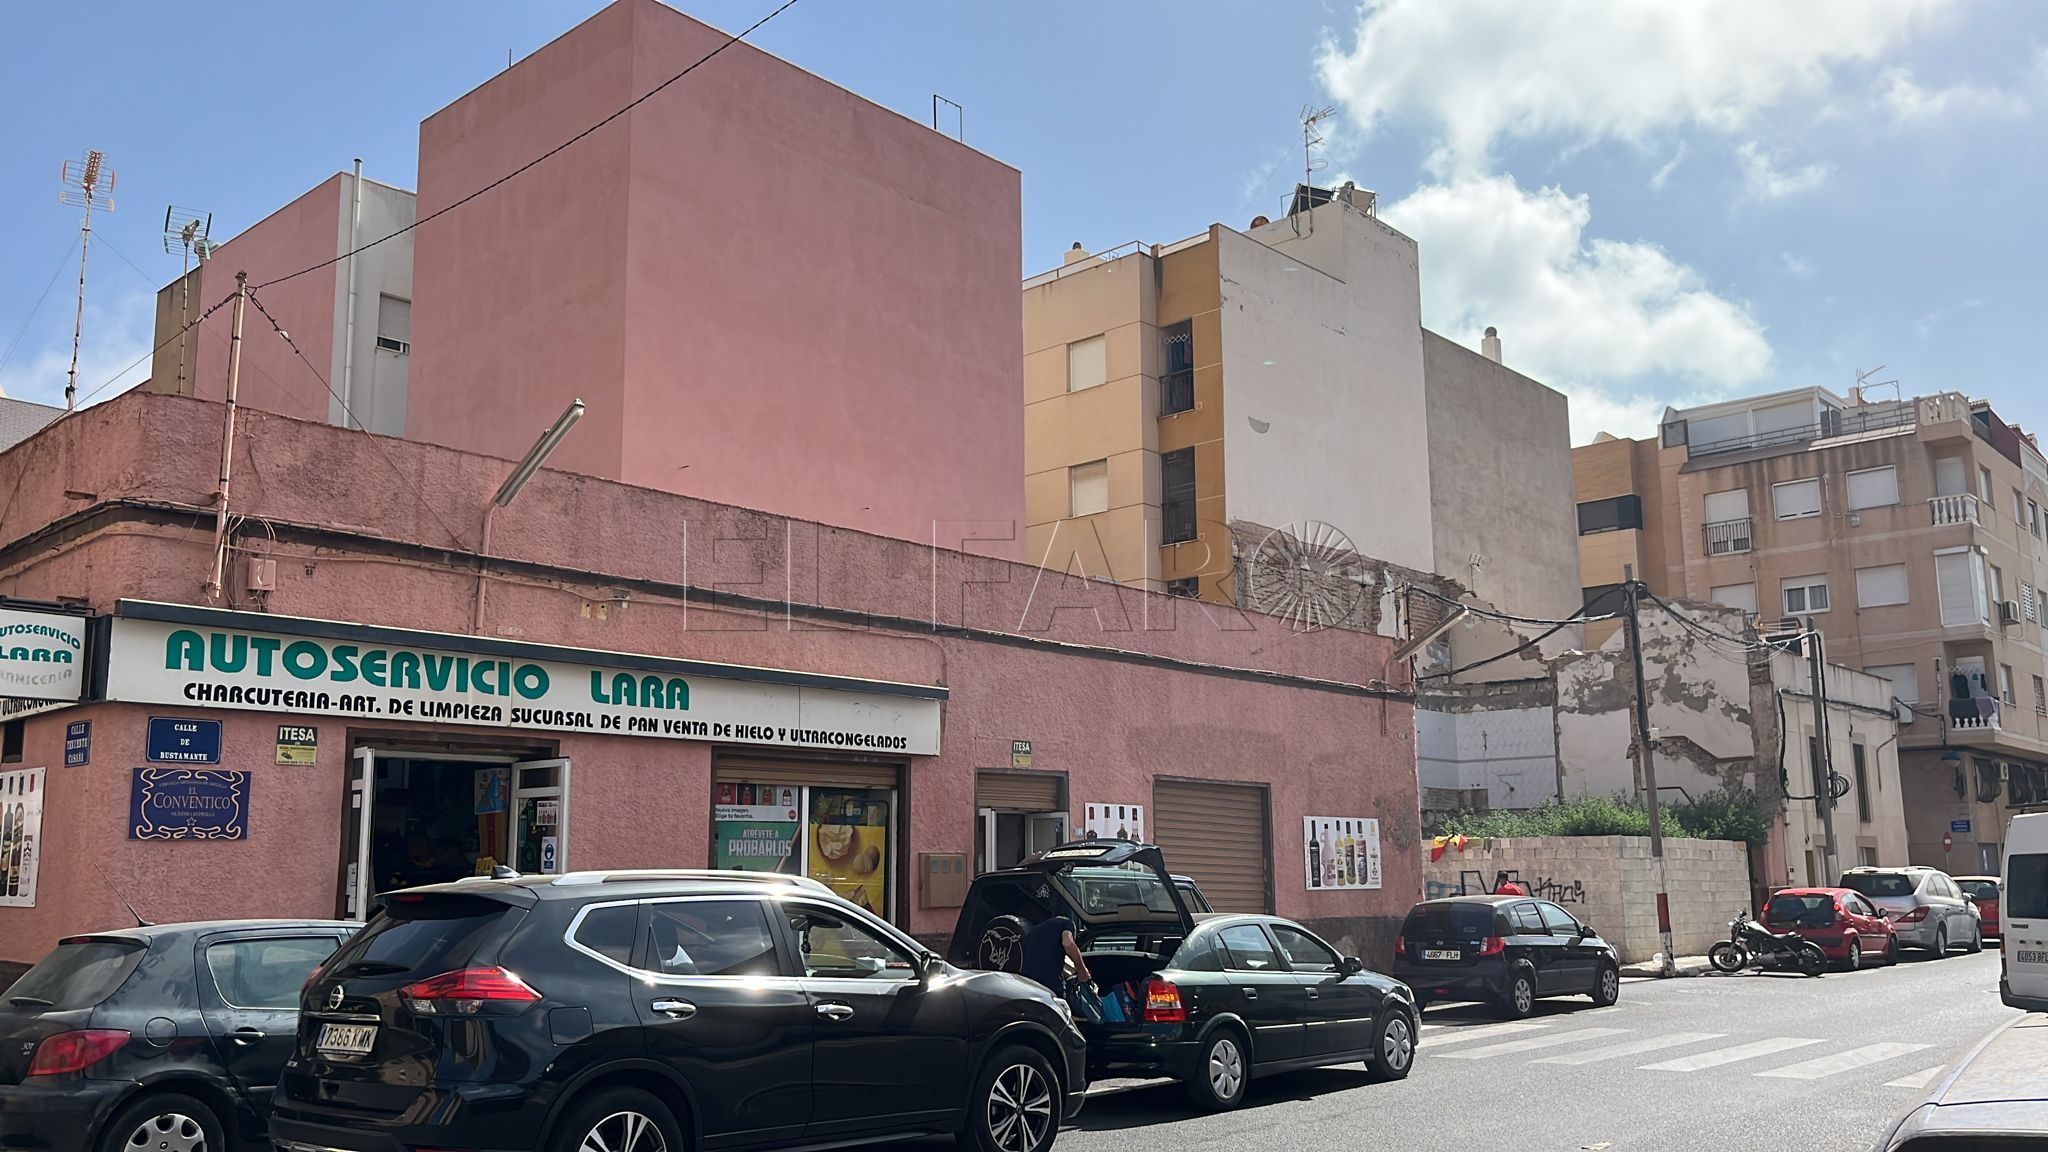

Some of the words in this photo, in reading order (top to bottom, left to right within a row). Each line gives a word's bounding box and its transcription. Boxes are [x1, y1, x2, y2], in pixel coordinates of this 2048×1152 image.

[165, 629, 550, 700] AUTOSERVICIO
[590, 670, 690, 711] LARA
[183, 682, 382, 713] CHARCUTERIA-ART.
[388, 698, 413, 716] DE
[420, 701, 502, 722] LIMPIEZA
[511, 707, 594, 728] SUCURSAL
[601, 714, 621, 730] DE
[628, 716, 658, 733] PAN
[663, 719, 708, 736] VENTA
[713, 722, 731, 738] DE
[735, 724, 774, 741] HIELO
[778, 727, 787, 742] Y
[790, 728, 907, 750] ULTRACONGELADOS
[174, 723, 198, 732] CALLE
[280, 726, 316, 742] ITESA
[180, 738, 190, 746] DE
[1013, 741, 1030, 752] ITESA
[160, 751, 208, 761] BUSTAMANTE
[188, 786, 198, 795] EL
[774, 829, 780, 839] A
[728, 839, 792, 857] PROBARLOS
[325, 1027, 352, 1047] 7386
